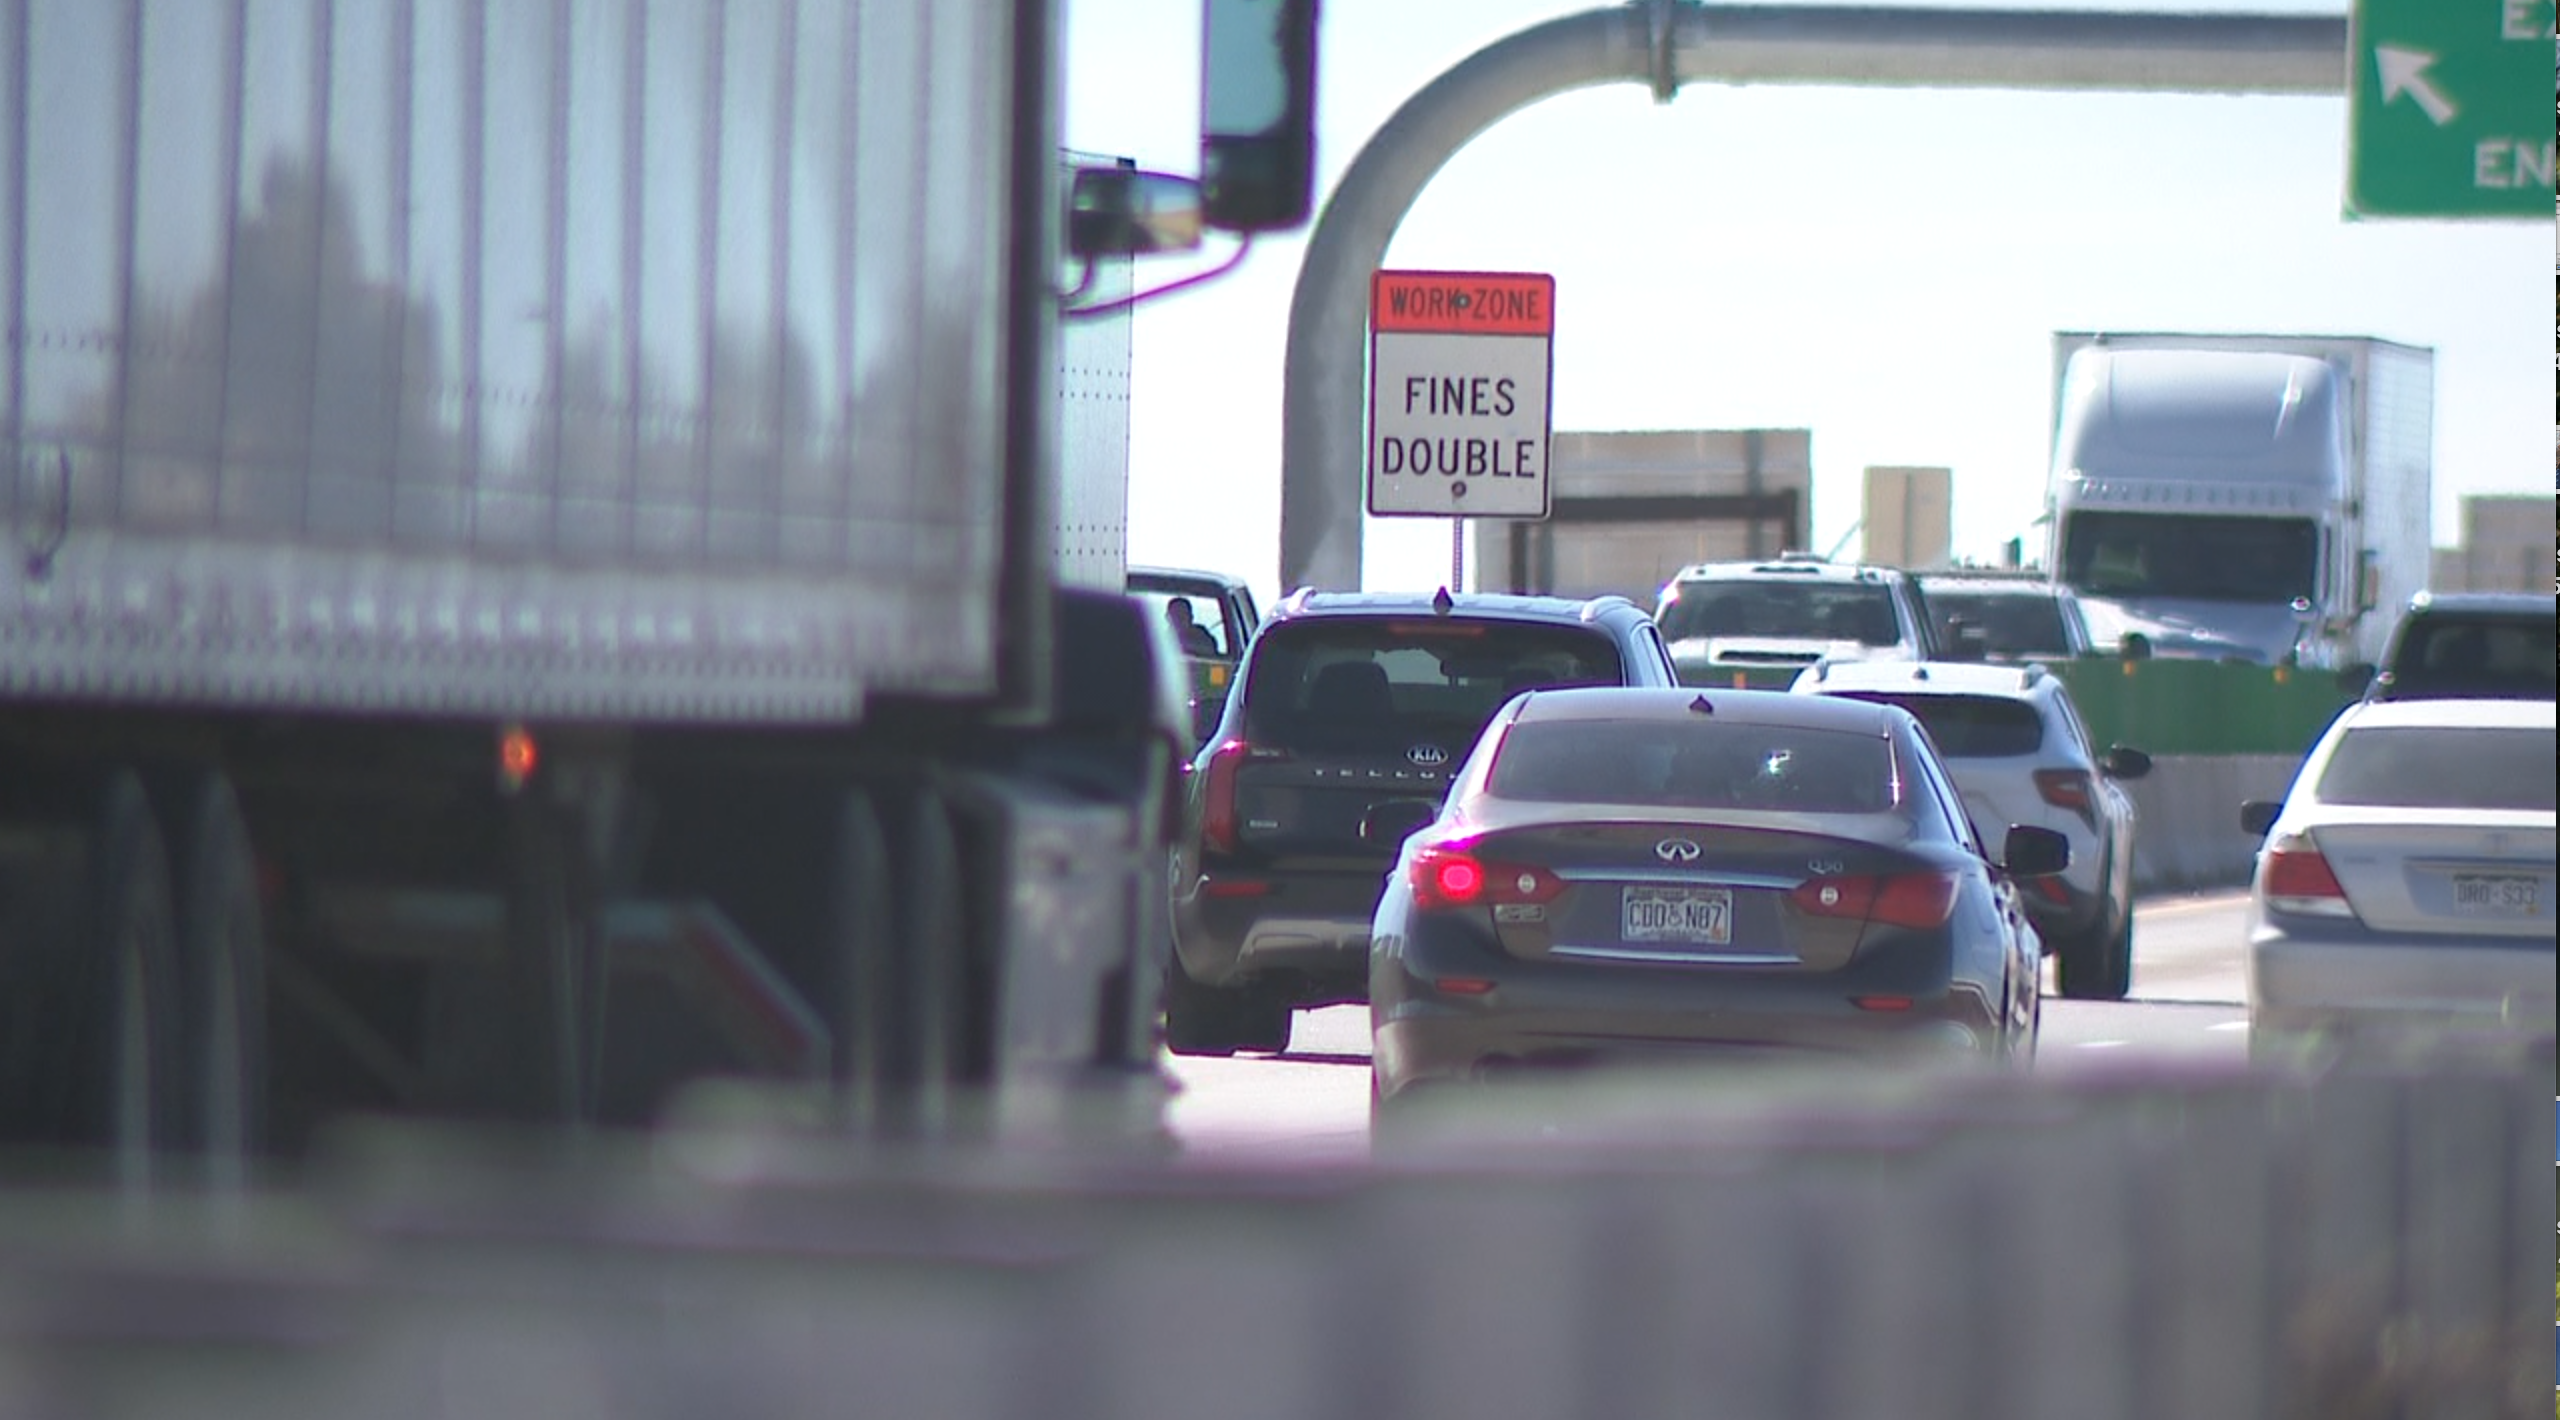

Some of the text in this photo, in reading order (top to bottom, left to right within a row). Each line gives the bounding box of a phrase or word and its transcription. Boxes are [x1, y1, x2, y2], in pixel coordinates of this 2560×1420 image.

[1390, 287, 1539, 320] WORK ZONE
[1406, 377, 1515, 416] FINES
[1383, 437, 1535, 478] DOUBLE
[1412, 748, 1443, 763] KIA
